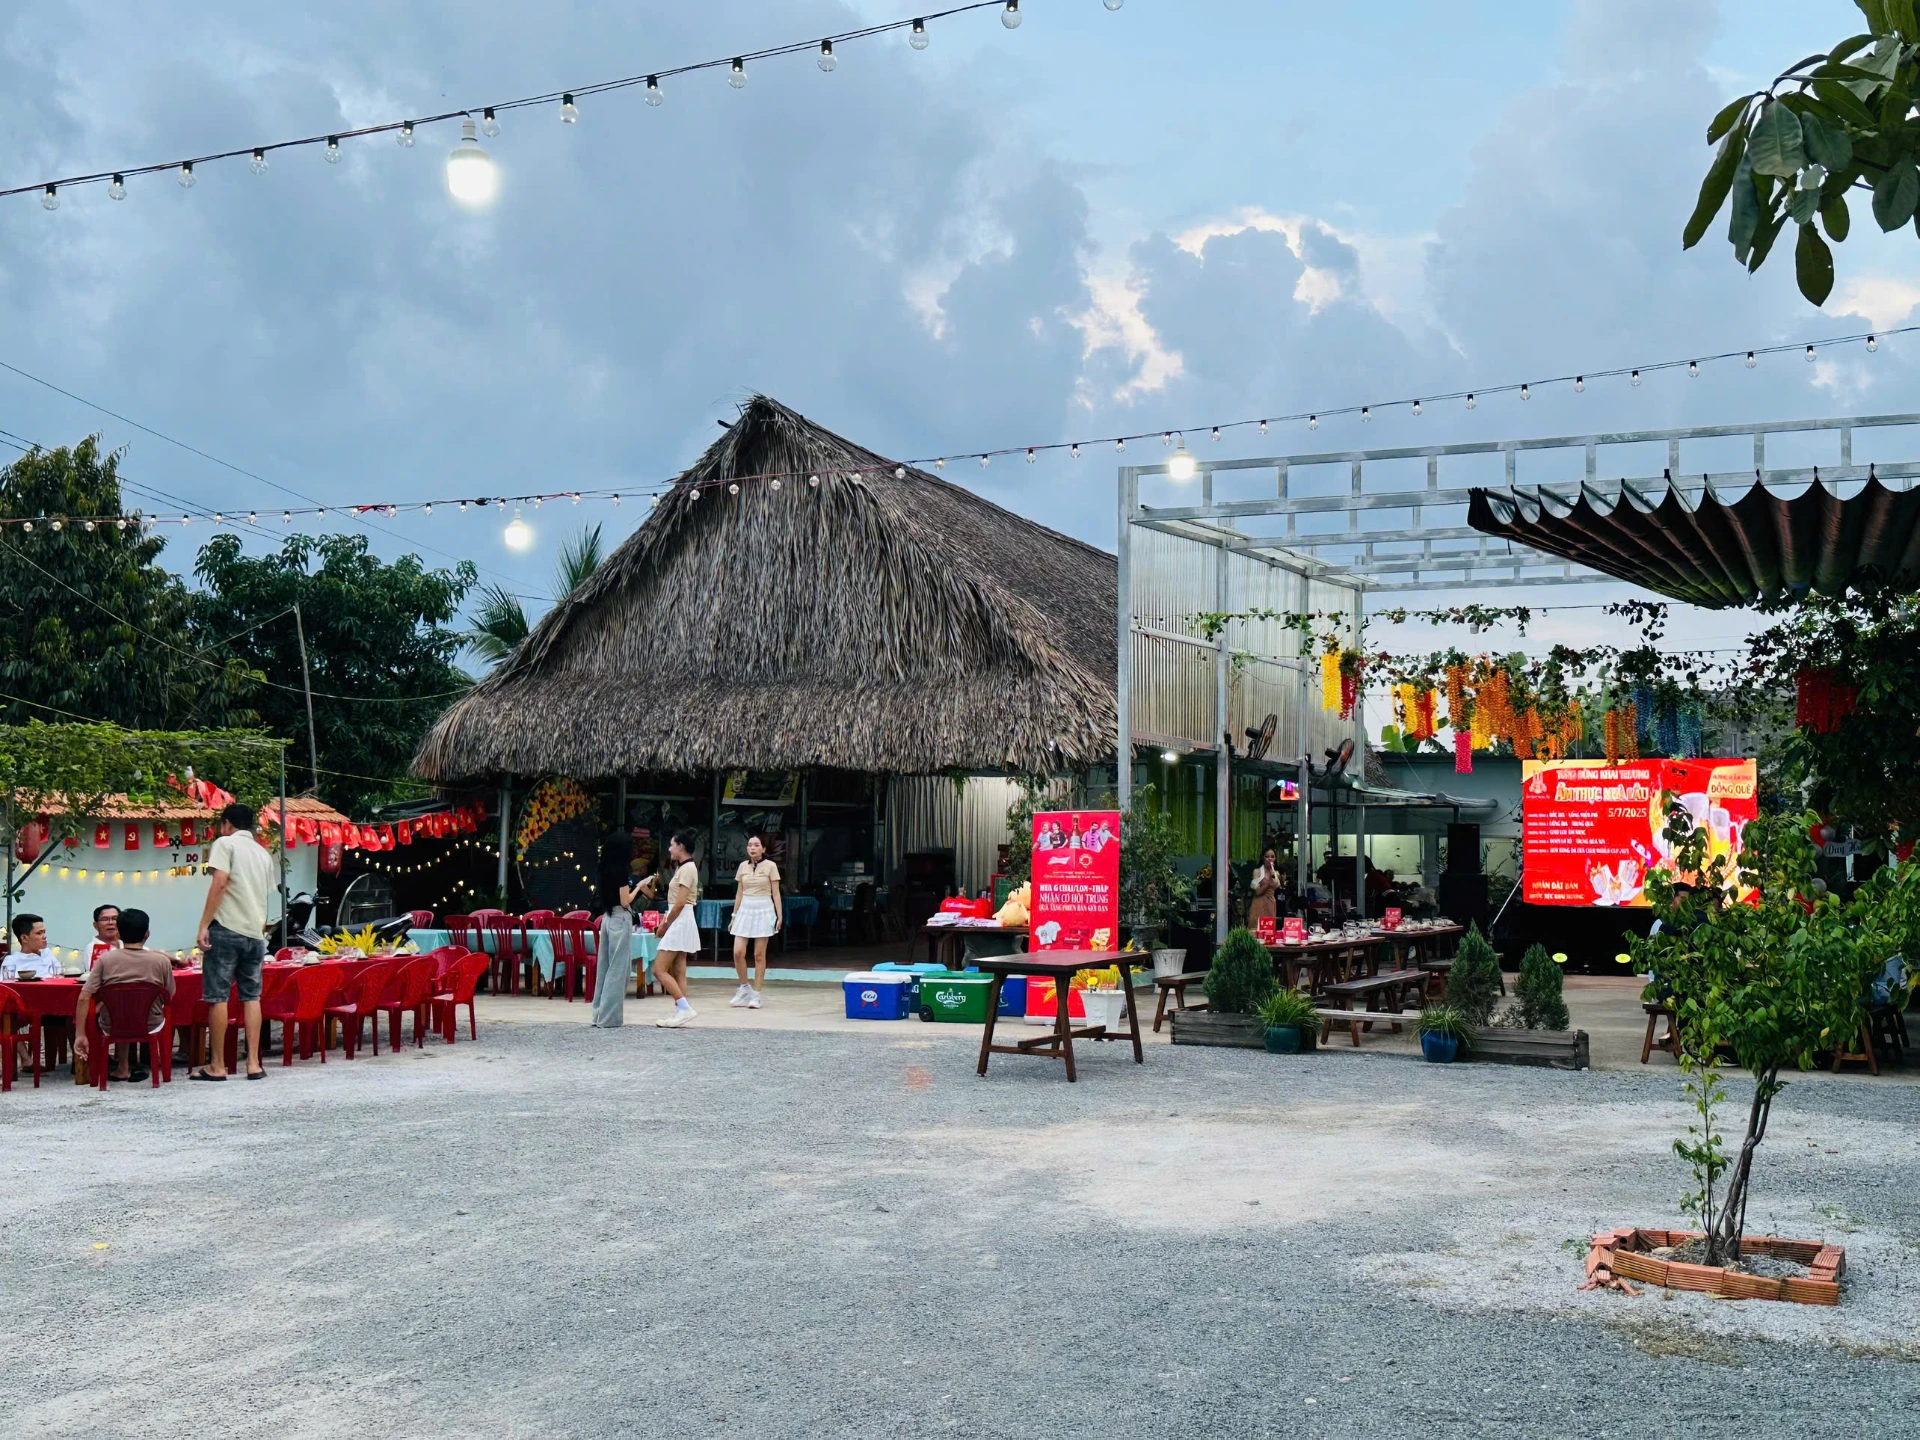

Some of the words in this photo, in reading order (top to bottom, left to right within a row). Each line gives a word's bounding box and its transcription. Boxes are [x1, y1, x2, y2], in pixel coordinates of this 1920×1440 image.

[1608, 808, 1647, 818] 5/7/2025
[172, 853, 179, 863] T
[936, 990, 966, 1004] Carlsberg
